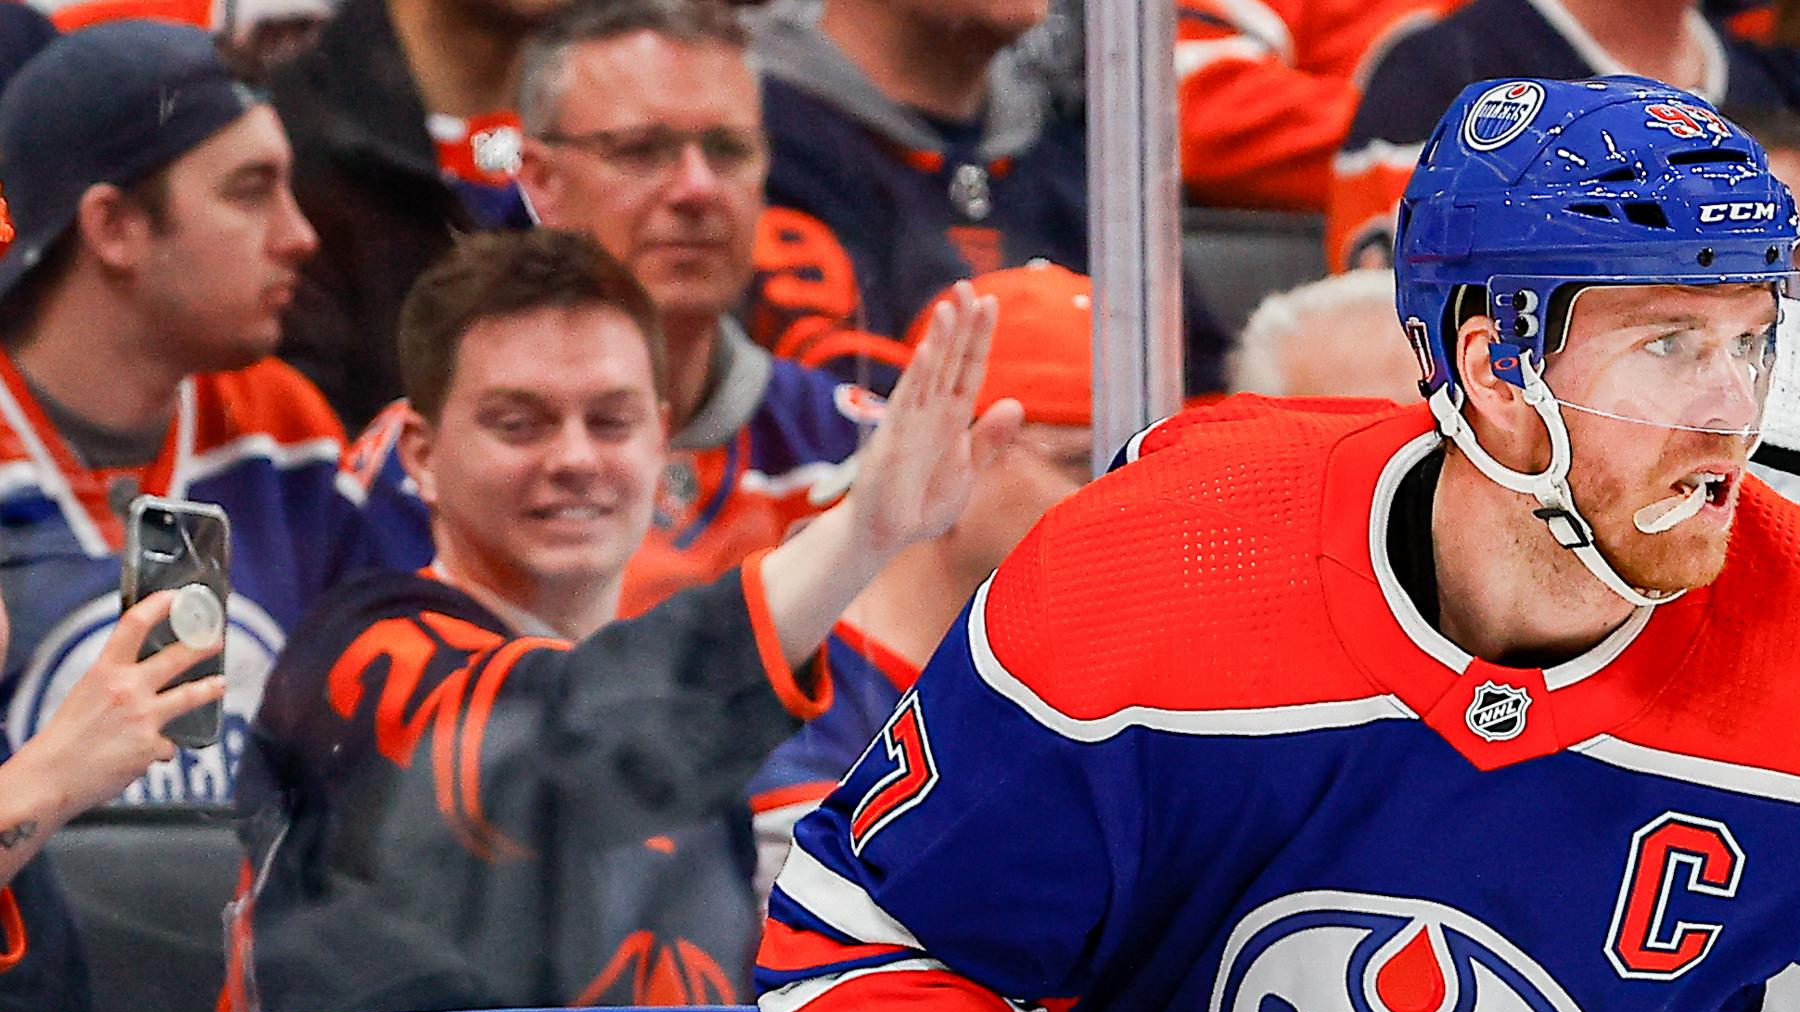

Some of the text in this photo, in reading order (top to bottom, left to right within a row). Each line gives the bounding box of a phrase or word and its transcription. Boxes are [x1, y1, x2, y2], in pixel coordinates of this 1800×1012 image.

[1700, 202, 1778, 223] CCM
[1478, 700, 1518, 725] NHL
[845, 688, 940, 858] 7
[1603, 810, 1746, 981] C
